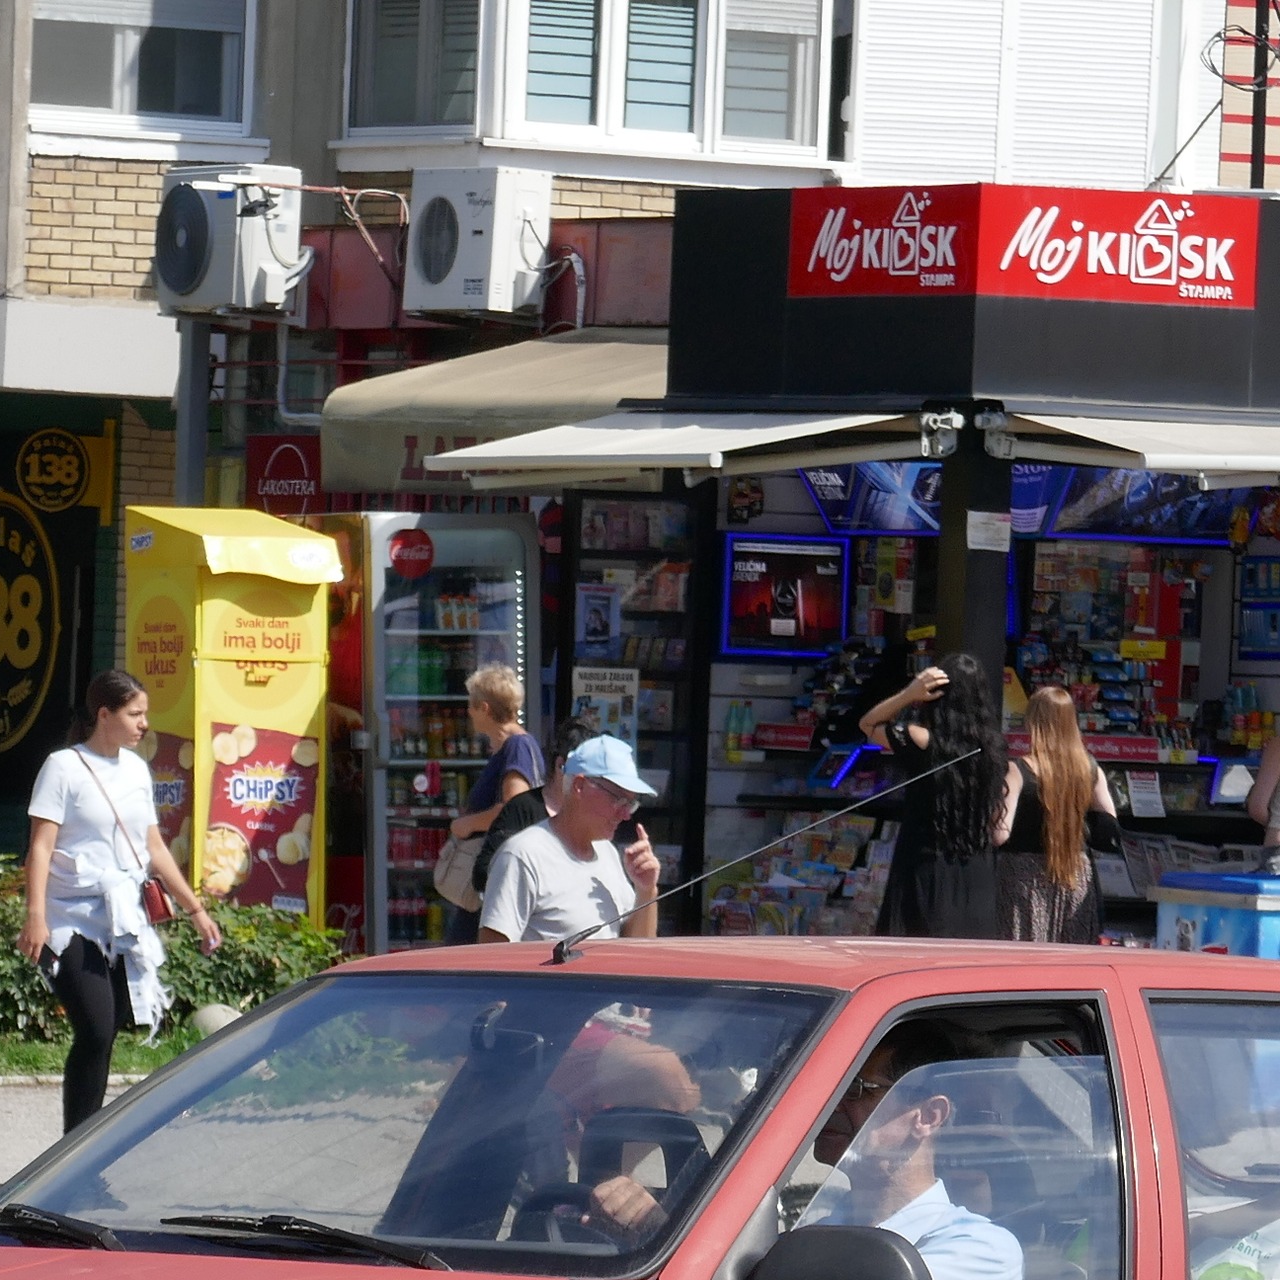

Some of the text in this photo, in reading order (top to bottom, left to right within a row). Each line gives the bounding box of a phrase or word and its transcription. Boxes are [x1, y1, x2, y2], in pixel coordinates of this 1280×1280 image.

[807, 206, 958, 282] Moj KIOSK
[1000, 206, 1235, 286] Moj KIOSK
[1179, 282, 1234, 300] ŠTAMPA
[25, 453, 80, 486] 138
[235, 617, 289, 629] Svaki dan
[137, 635, 184, 657] ima bolji
[223, 631, 301, 653] ima bolji
[144, 655, 177, 676] ukus
[153, 780, 182, 805] HiPSY
[232, 777, 297, 803] CHiPSY
